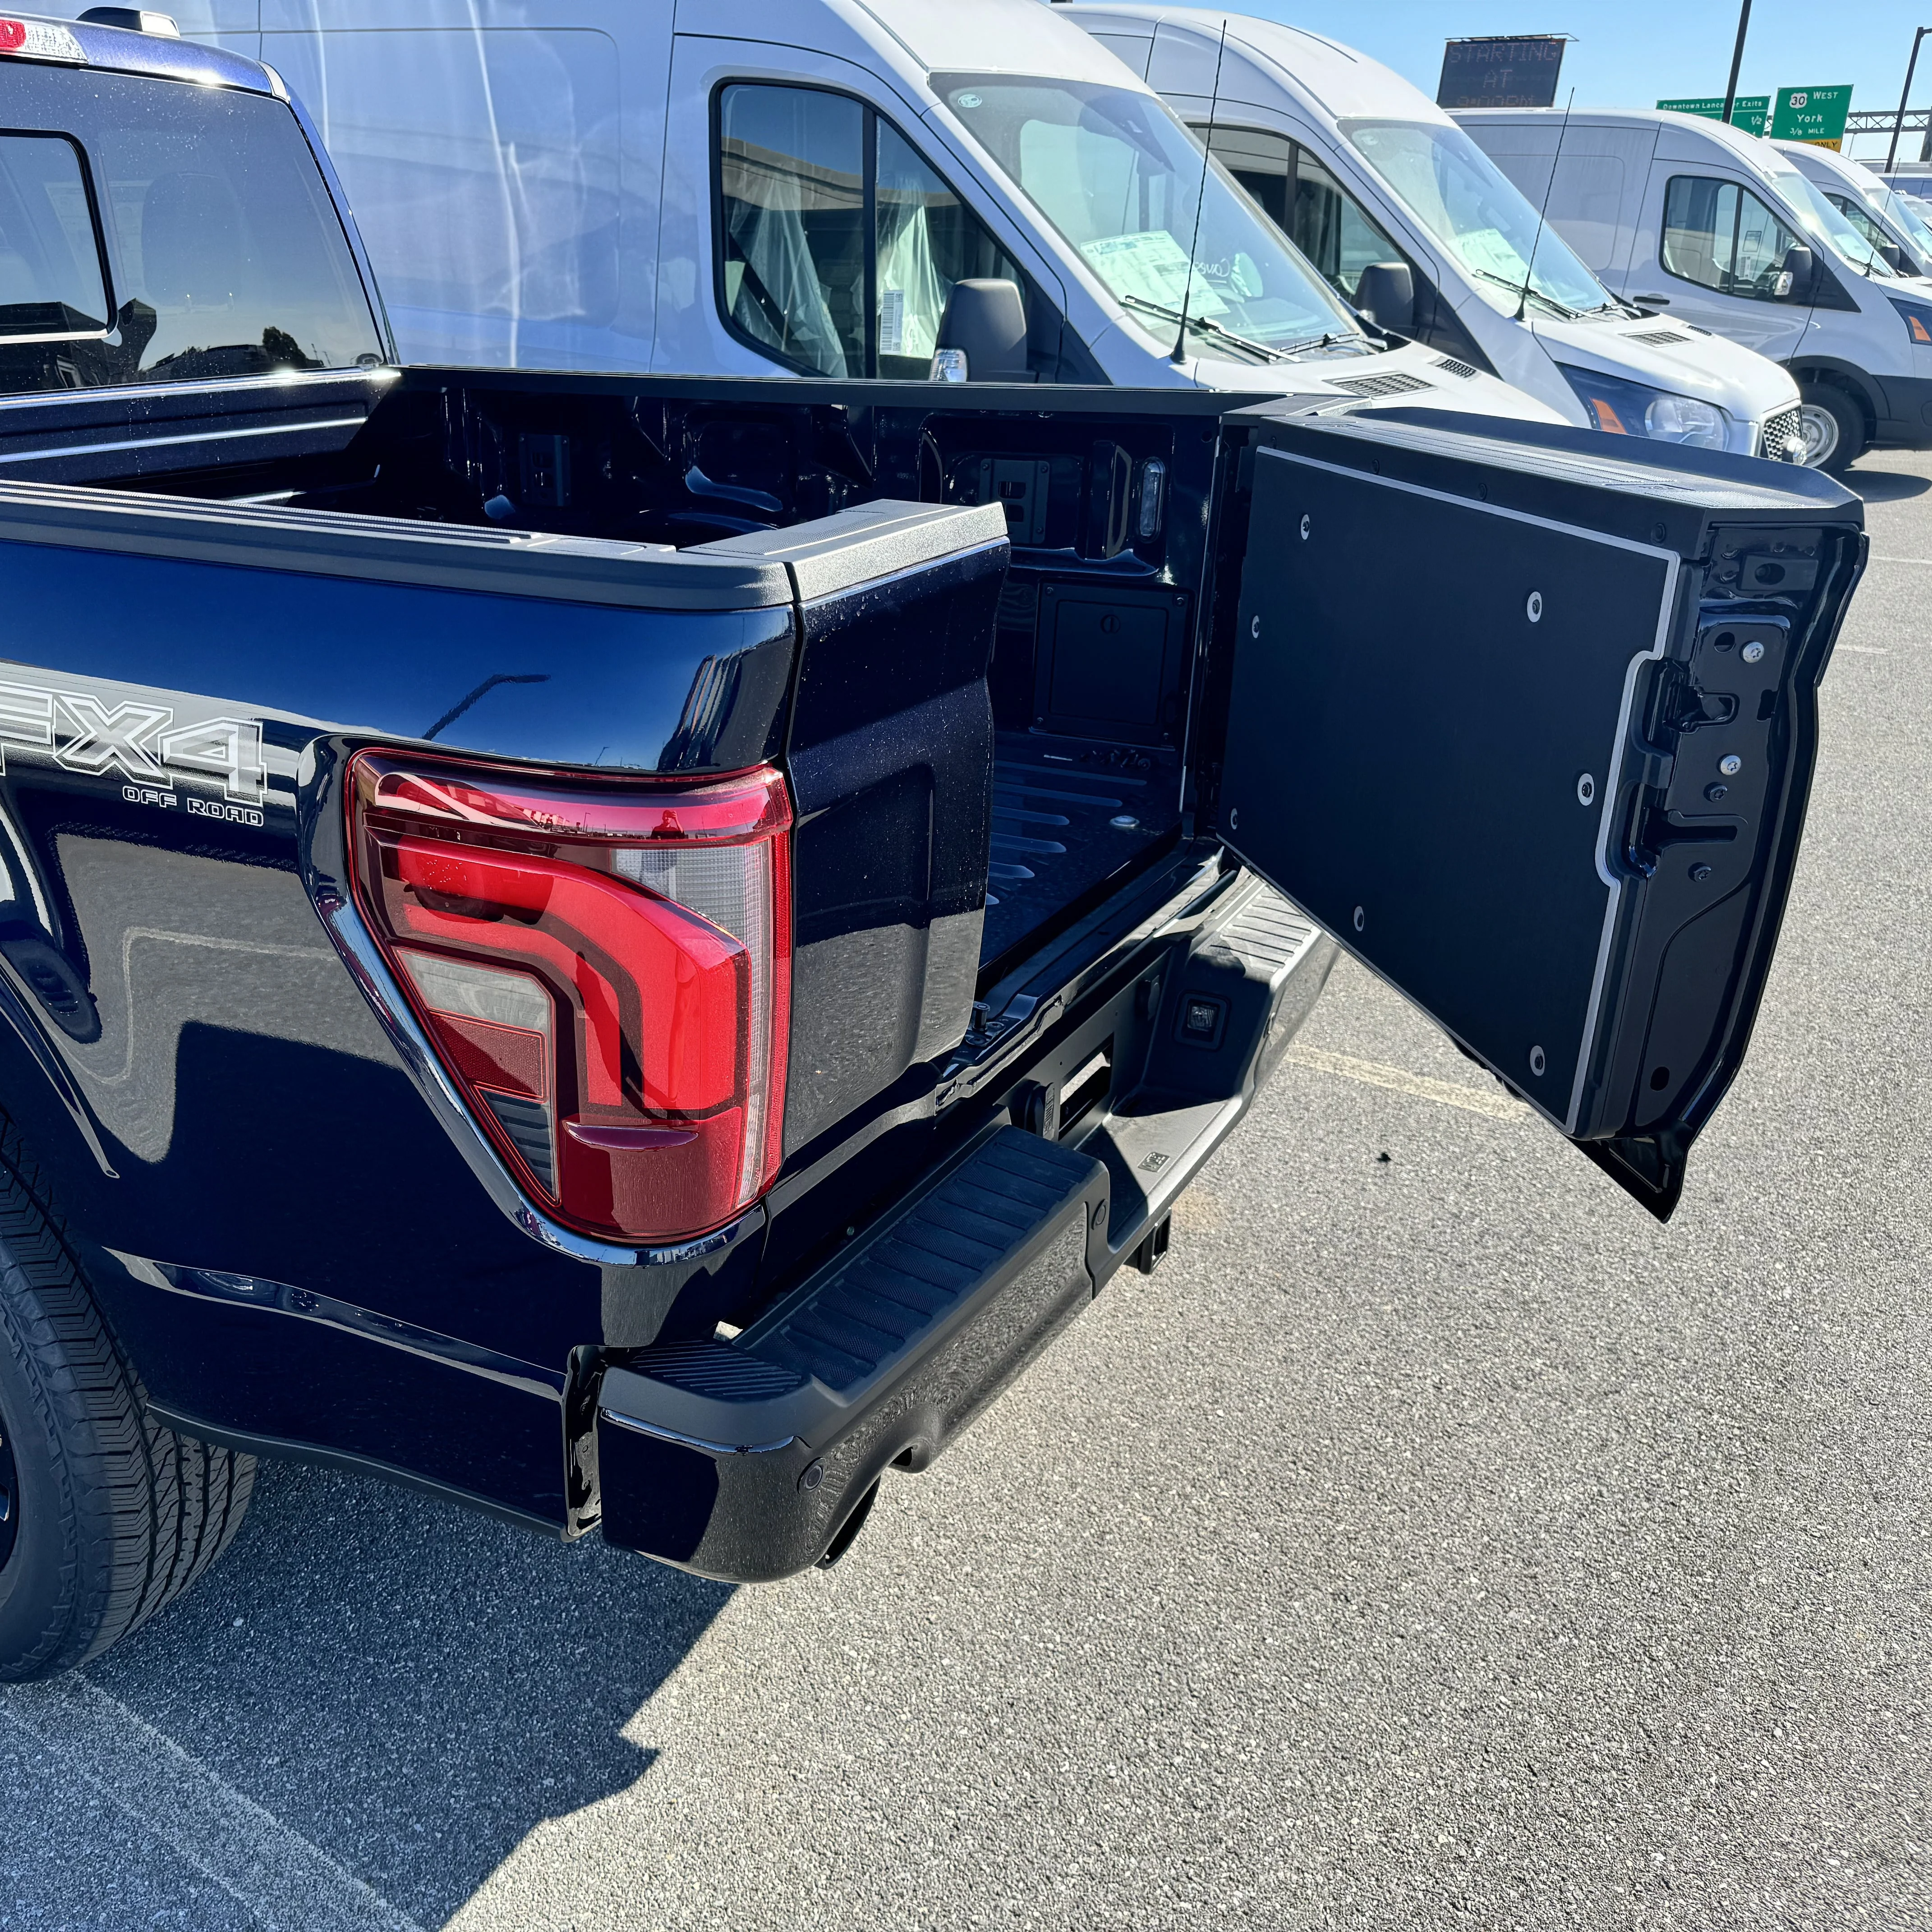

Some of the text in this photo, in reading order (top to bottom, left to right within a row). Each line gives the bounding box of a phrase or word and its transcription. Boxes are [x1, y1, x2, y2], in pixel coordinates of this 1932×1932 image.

[1449, 41, 1558, 63] STARTING
[1483, 69, 1513, 88] AT
[1791, 91, 1839, 106] 30 WEST
[1797, 114, 1823, 123] York
[122, 785, 264, 827] OFF ROAD
